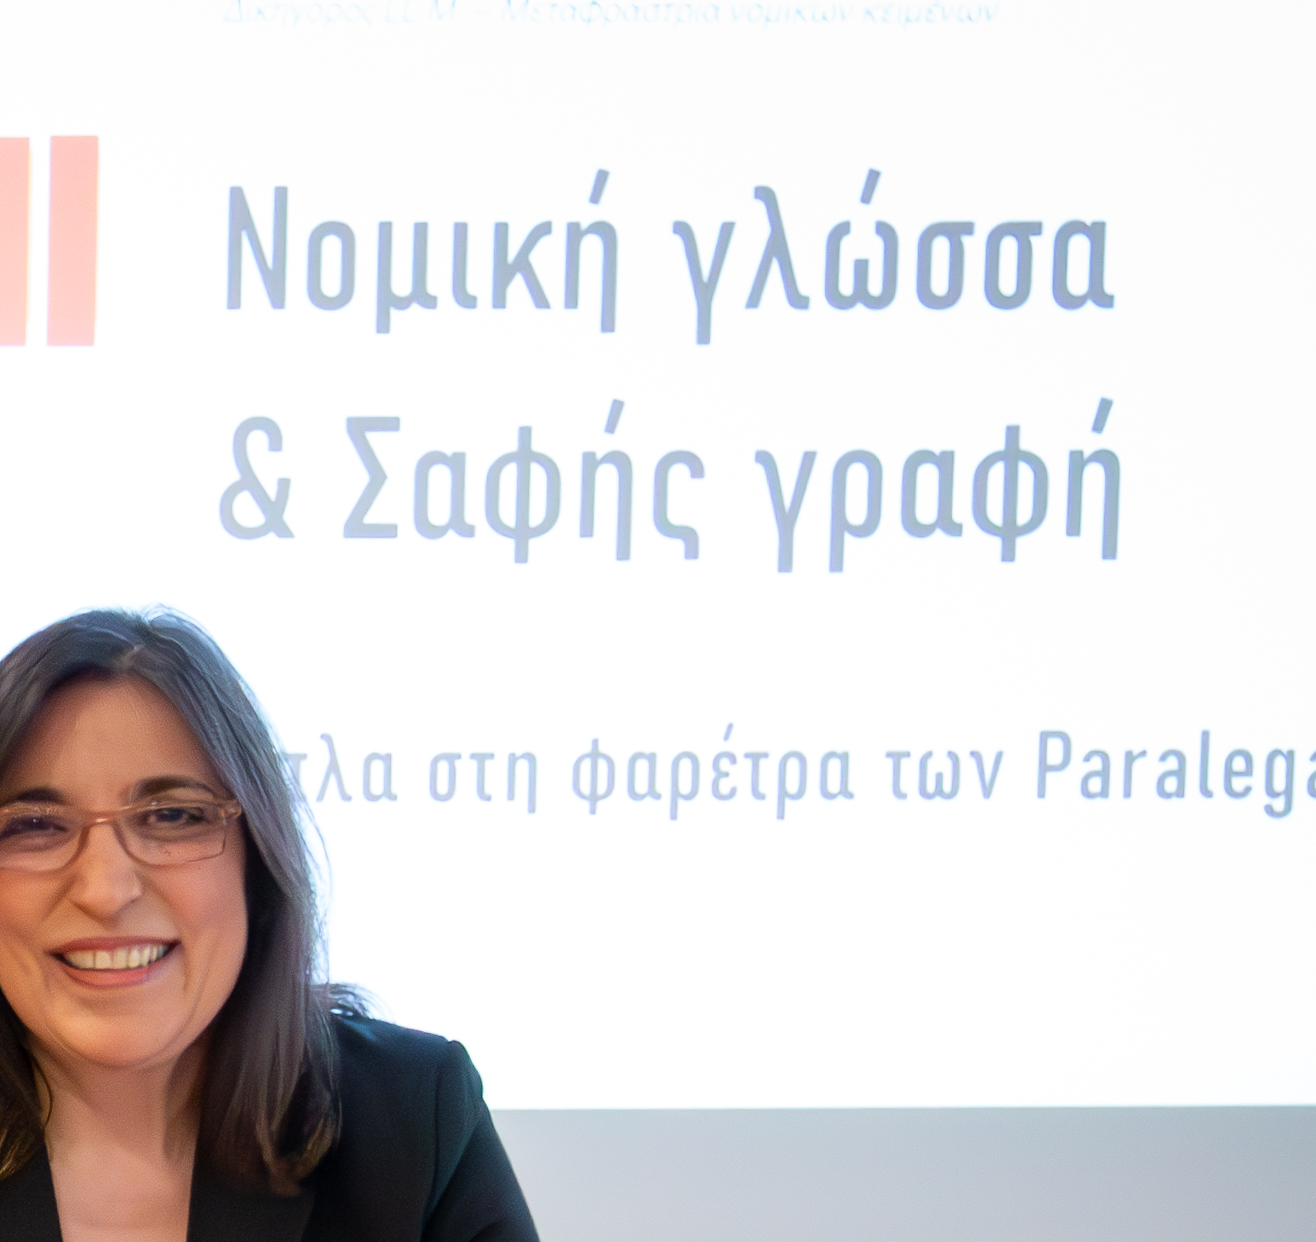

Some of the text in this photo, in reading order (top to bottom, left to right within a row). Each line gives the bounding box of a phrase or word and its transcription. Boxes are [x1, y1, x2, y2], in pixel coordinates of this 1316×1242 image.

[225, 168, 1115, 346] Νομική γλώσσα
[218, 397, 1123, 574] & Σαφής γραφή
[428, 750, 539, 816] στη
[571, 722, 855, 821] φαρέτρα
[884, 749, 1005, 802] των
